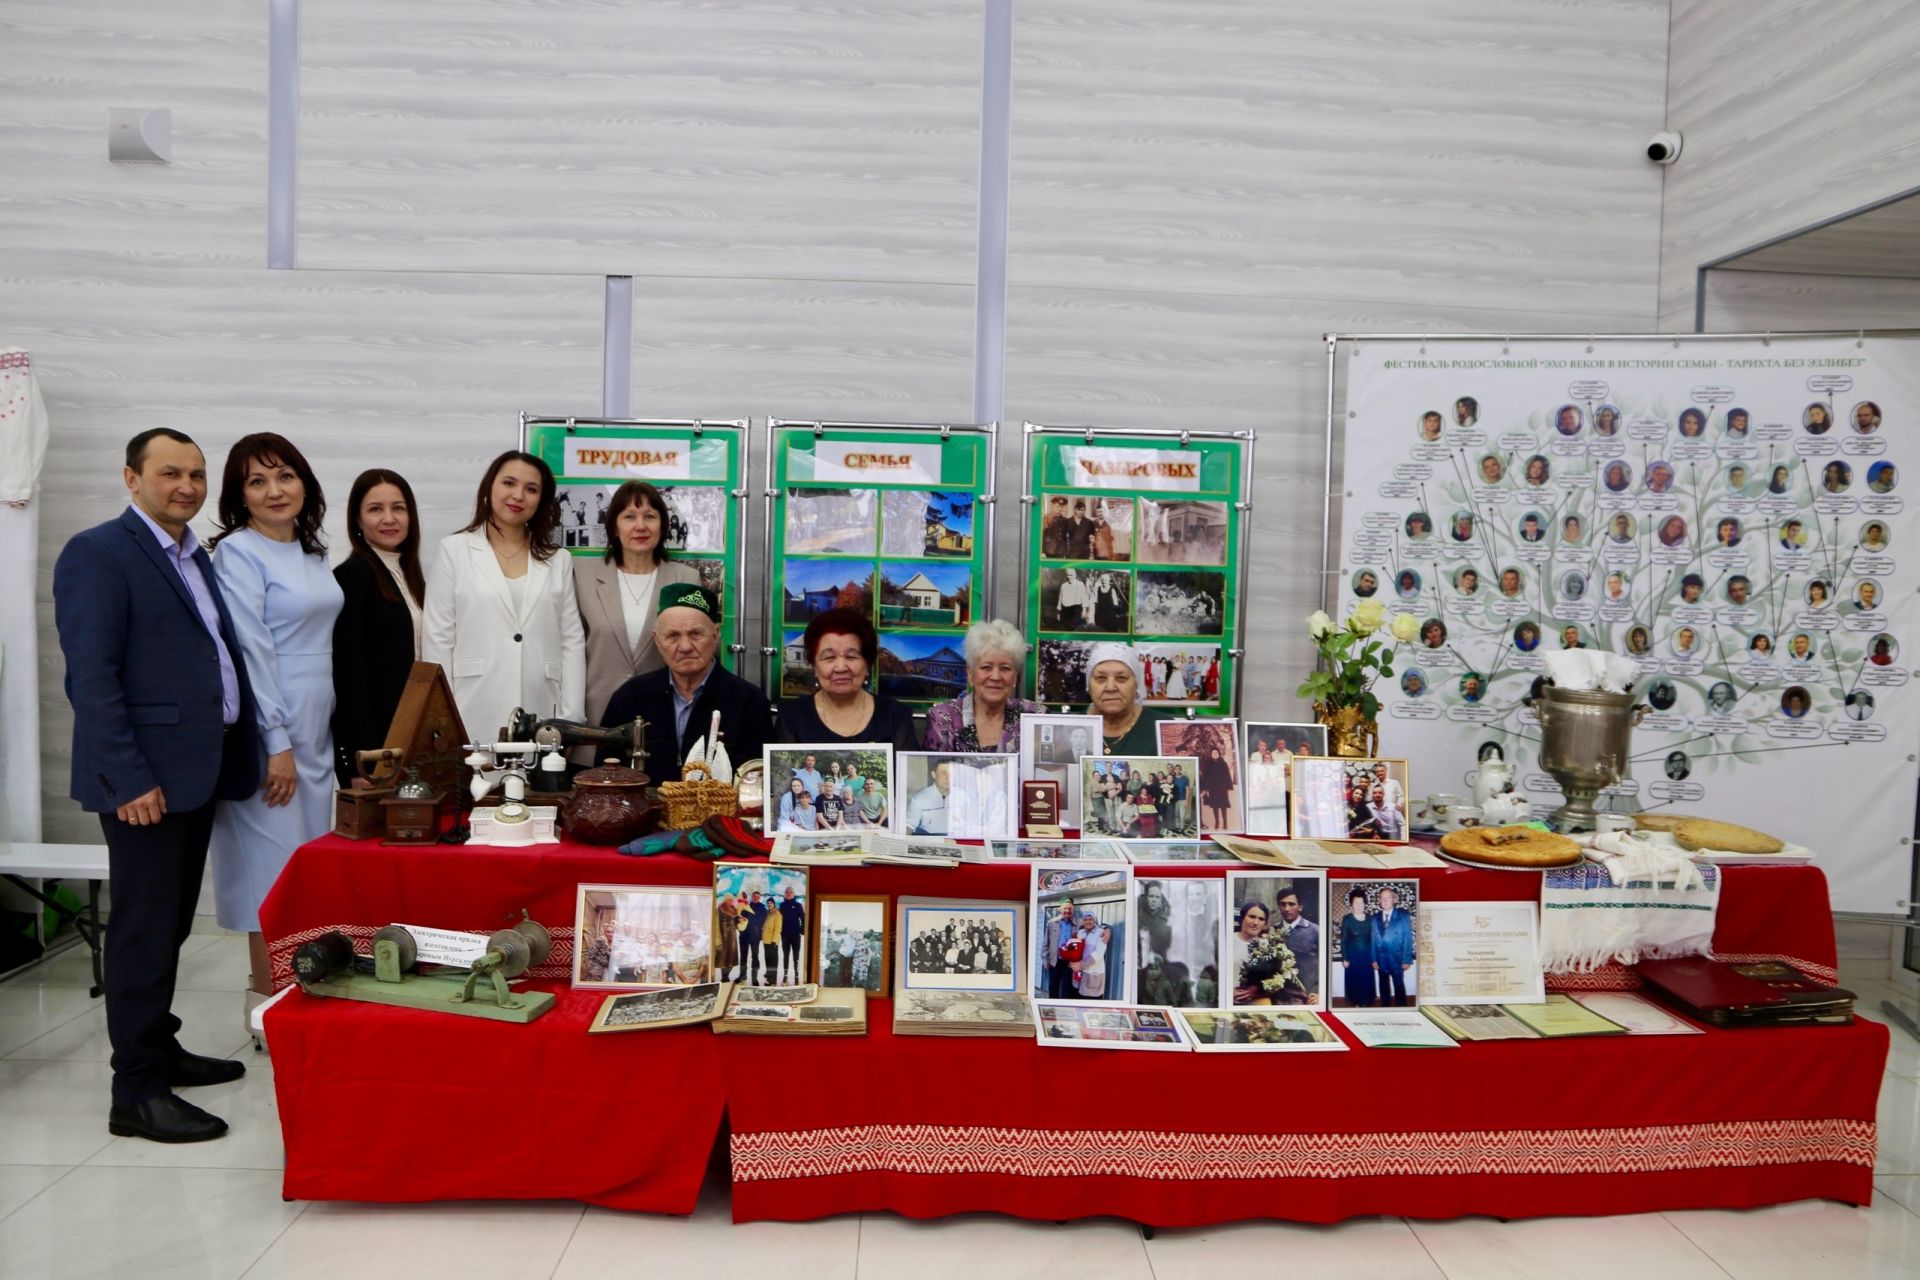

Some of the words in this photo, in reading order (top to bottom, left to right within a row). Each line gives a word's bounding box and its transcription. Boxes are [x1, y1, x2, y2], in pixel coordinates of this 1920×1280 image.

[1384, 359, 1450, 369] ФЕСТИВАЛЬ
[1451, 357, 1538, 369] РОДОСЛОВНОЙ
[1570, 359, 1605, 369] ВЕКОВ
[1608, 359, 1615, 369] В
[1617, 359, 1674, 369] ИСТОРИИ
[1676, 359, 1717, 368] СЕМЬИ
[1726, 358, 1781, 368] ТАРИХТА
[1783, 358, 1804, 368] БЕЗ
[577, 449, 679, 468] ТРУДОВАЯ
[844, 452, 912, 469] СЕМЬЯ
